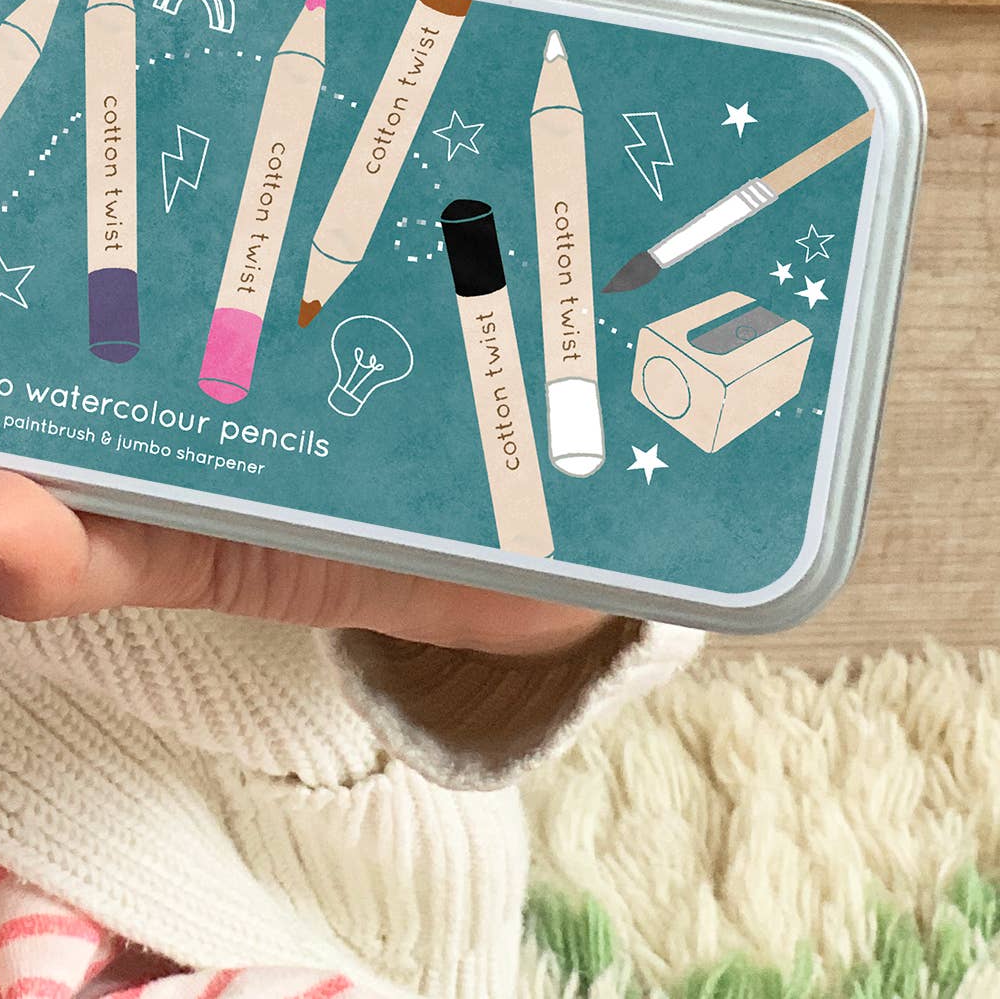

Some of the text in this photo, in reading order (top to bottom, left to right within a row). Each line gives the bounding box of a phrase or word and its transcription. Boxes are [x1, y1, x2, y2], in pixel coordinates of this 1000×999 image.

[103, 95, 124, 252] cotton twist
[365, 26, 440, 175] cotton twist
[236, 142, 286, 294] cotton twist
[553, 200, 582, 362] cotton twist
[3, 415, 96, 443] paintbrush
[100, 430, 112, 446] &
[115, 434, 172, 457] jumbo
[176, 446, 266, 475] sharpener
[25, 382, 211, 434] watercolour
[219, 420, 330, 458] pencils
[475, 311, 520, 471] cotton twist
